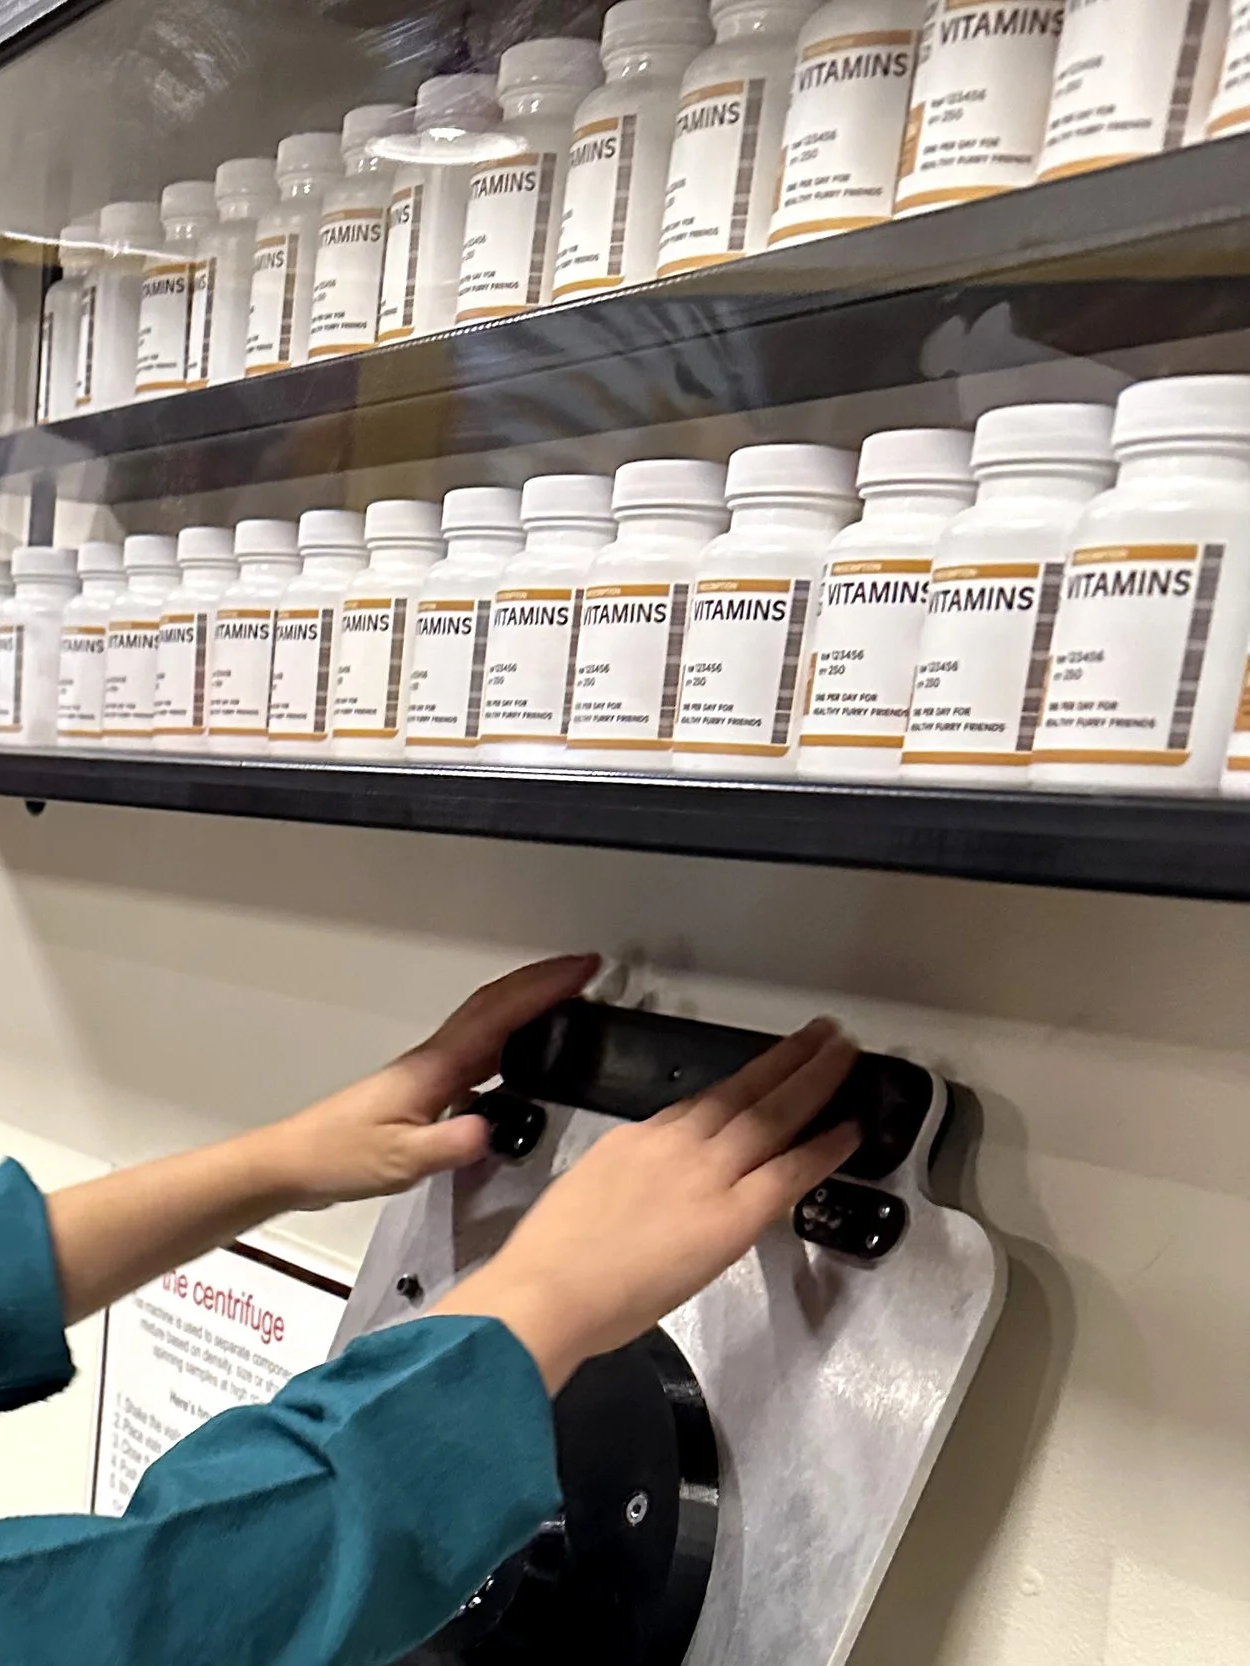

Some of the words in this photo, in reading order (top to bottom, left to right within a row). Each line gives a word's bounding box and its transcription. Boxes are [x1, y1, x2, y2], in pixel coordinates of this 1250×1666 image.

[472, 171, 537, 198] TAMINS
[321, 224, 382, 245] TAMINS
[829, 580, 930, 606] VITAMINS
[694, 599, 787, 621] VITAMINS
[192, 1280, 285, 1345] centrifuge
